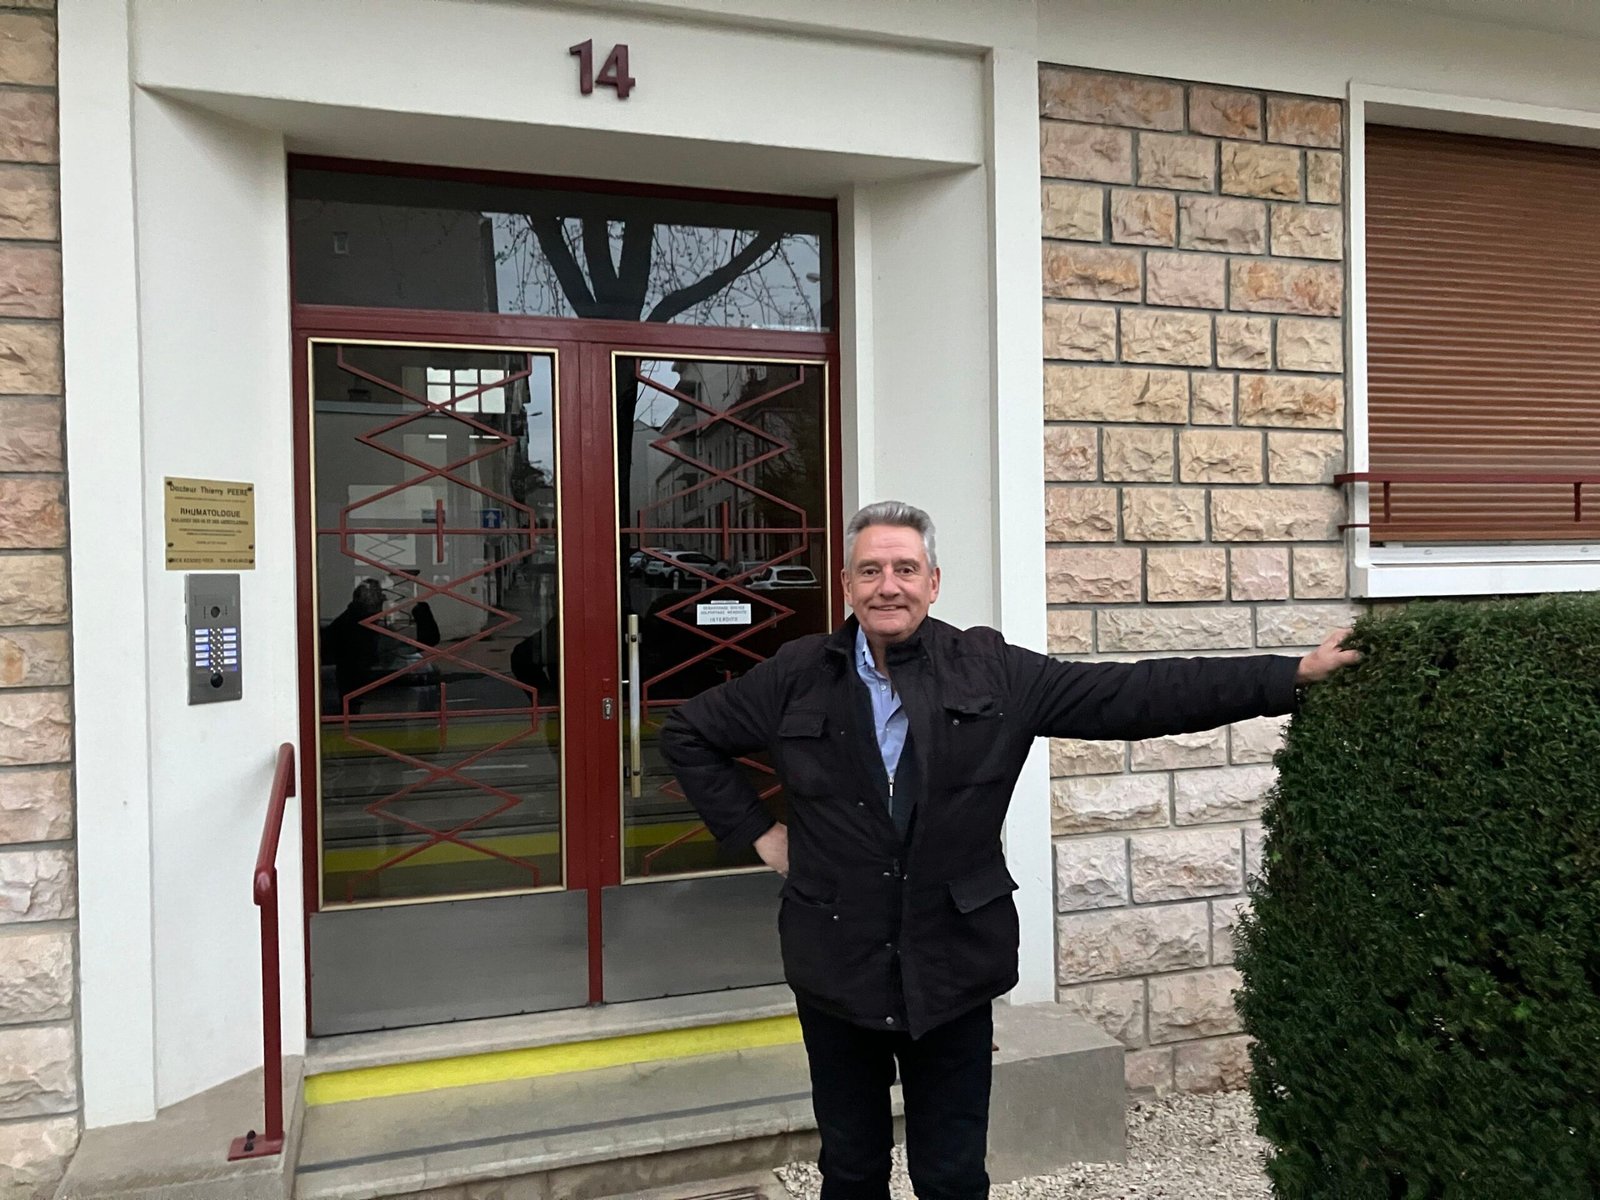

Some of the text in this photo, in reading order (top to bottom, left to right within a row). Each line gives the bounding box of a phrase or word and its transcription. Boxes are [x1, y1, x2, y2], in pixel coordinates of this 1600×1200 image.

[569, 38, 636, 99] 14
[169, 484, 197, 493] Docteur
[200, 485, 224, 496] Thierry
[180, 507, 241, 518] RHUMATOLOGUE
